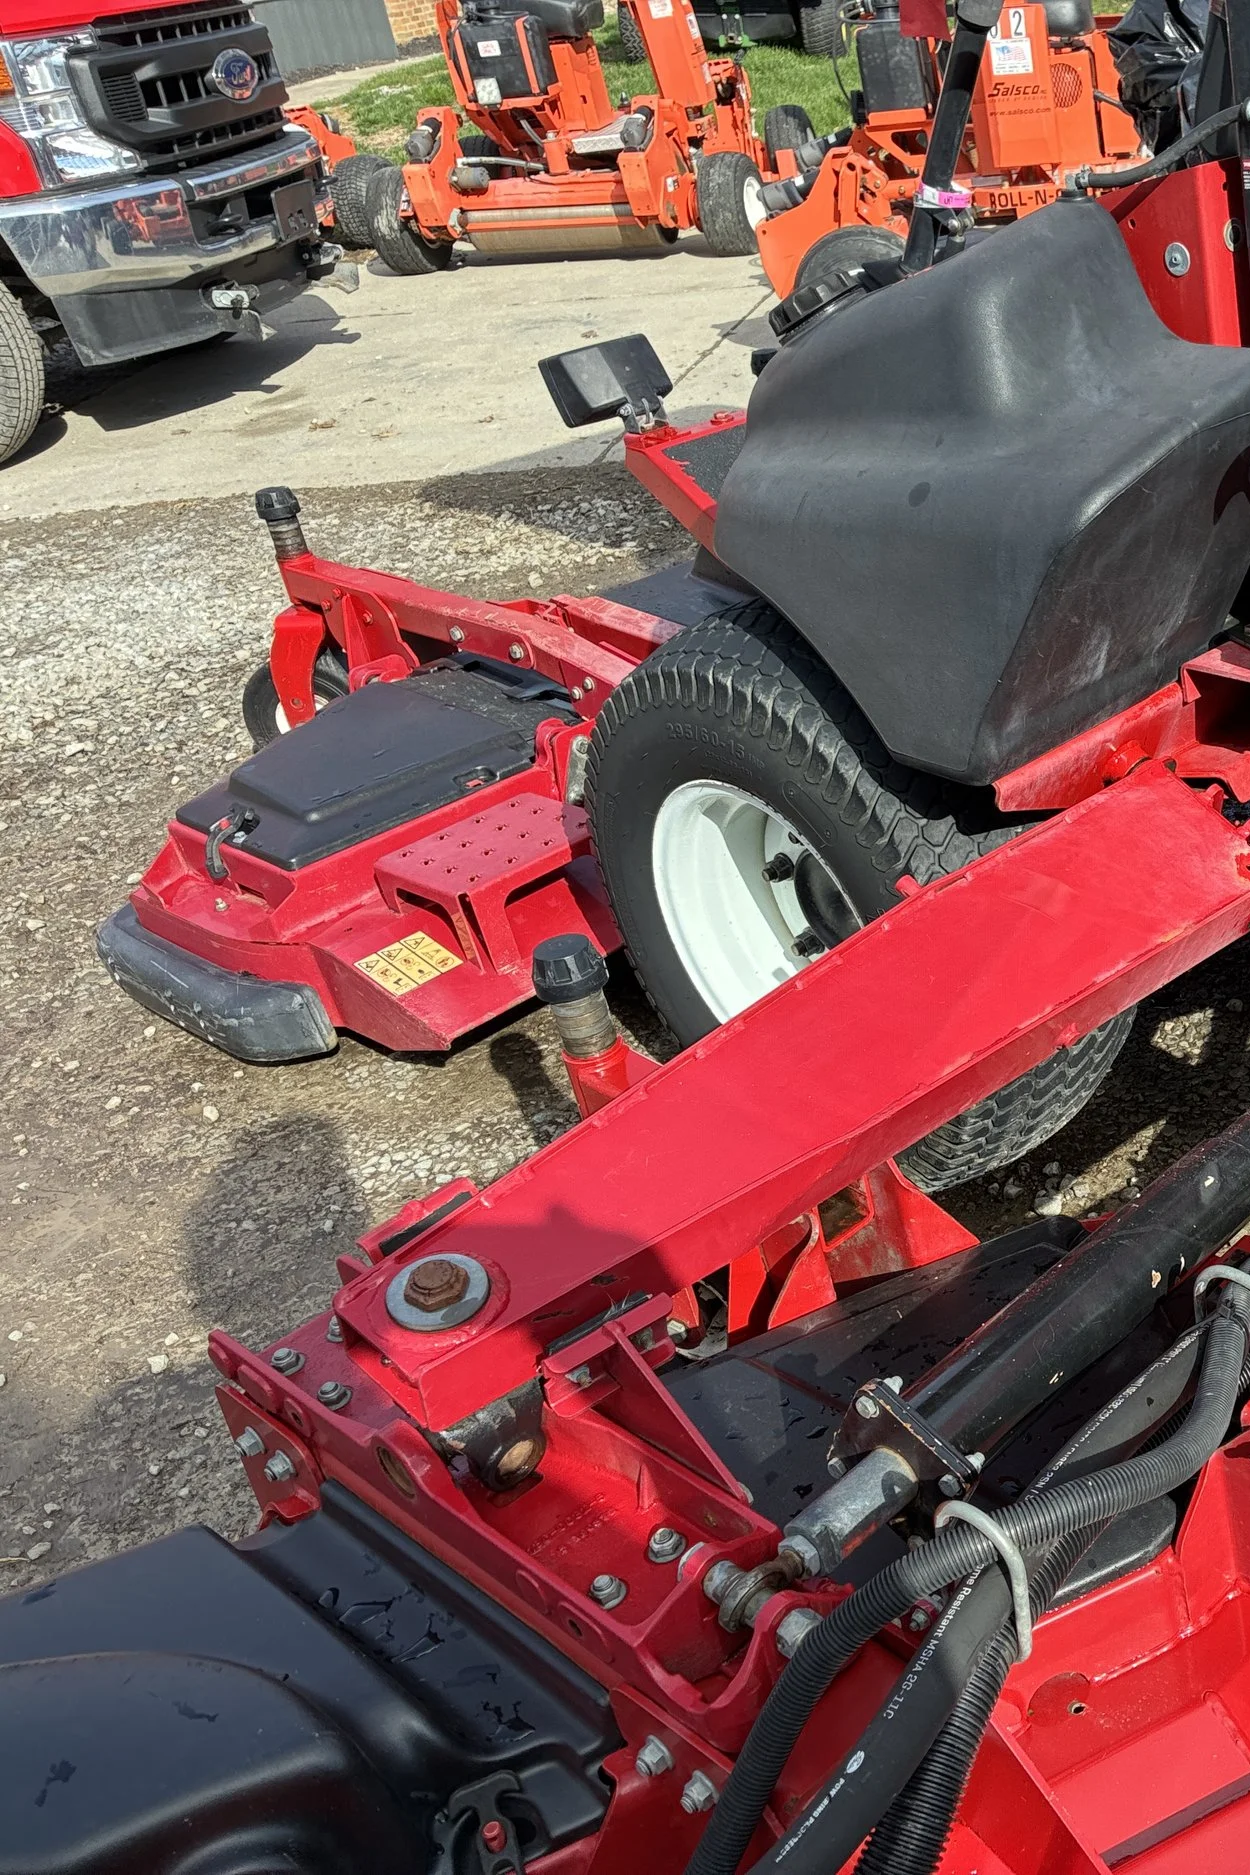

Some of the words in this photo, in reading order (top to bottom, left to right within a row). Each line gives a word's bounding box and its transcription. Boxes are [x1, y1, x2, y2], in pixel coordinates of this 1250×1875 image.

[988, 82, 1040, 98] Salsco
[934, 1586, 972, 1637] Resistant
[912, 1639, 940, 1672] MSHA
[883, 1674, 918, 1720] 2G-11C
